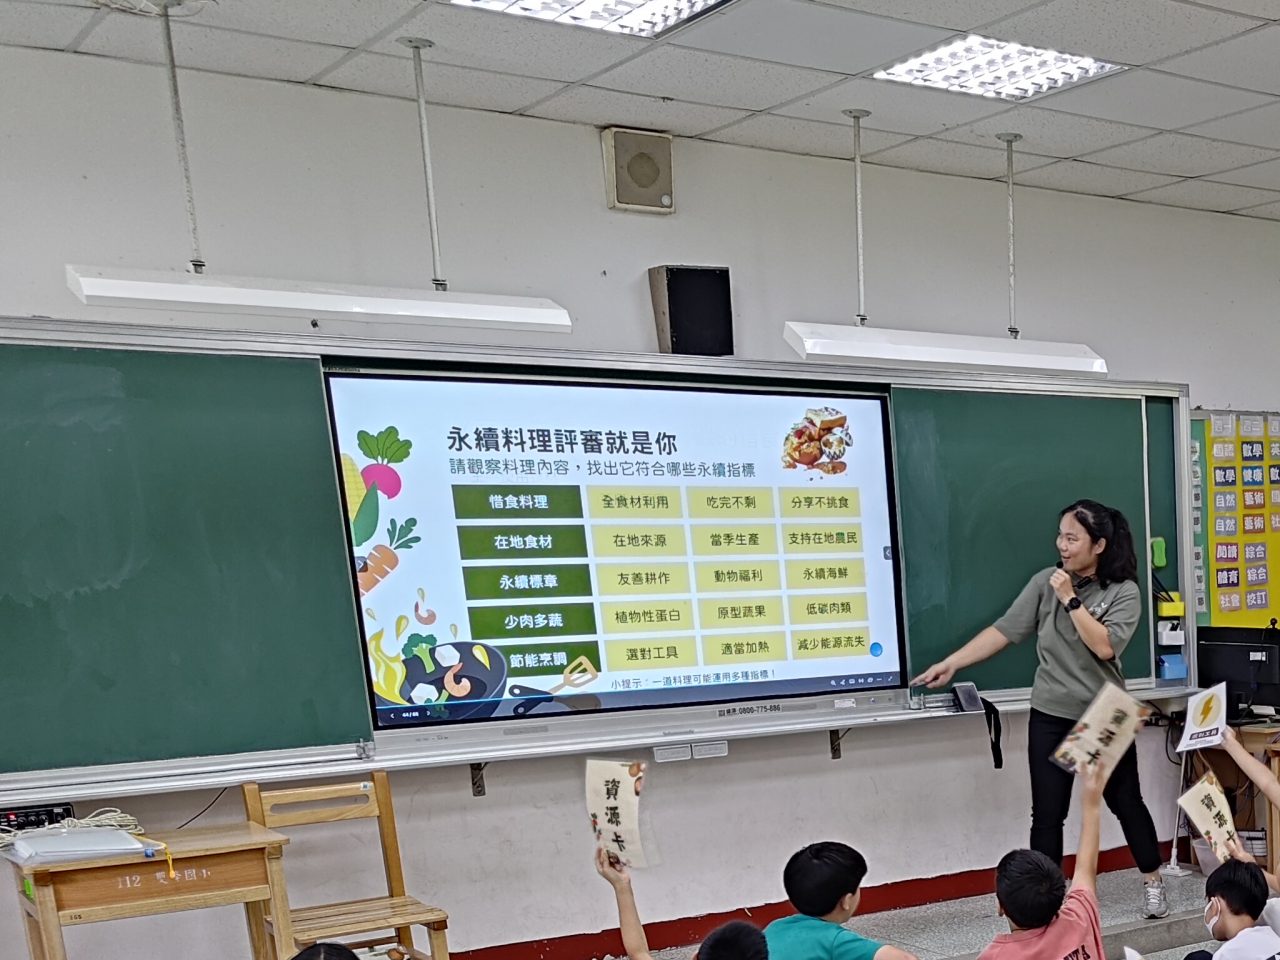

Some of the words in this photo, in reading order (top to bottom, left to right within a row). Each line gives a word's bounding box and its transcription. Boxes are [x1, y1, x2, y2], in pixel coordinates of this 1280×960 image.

[447, 426, 678, 455] 永續料理評審就是你
[1213, 445, 1235, 457] 國語
[1242, 443, 1262, 457] 數學
[1215, 469, 1236, 482] 數學
[489, 494, 549, 509] 惜食料理
[601, 495, 669, 509] 全食材利用
[706, 495, 757, 510] 吃完不剩
[791, 496, 850, 510] 分享不挑食
[1216, 494, 1235, 507] 自然
[1244, 491, 1264, 505] 藝術
[1216, 518, 1235, 531] 自然
[1244, 516, 1264, 530] 藝術
[494, 535, 552, 549] 在地食材
[612, 534, 667, 547] 在地來源
[709, 533, 760, 547] 當季生產
[788, 532, 858, 545] 支持在地農民
[1245, 545, 1265, 558] 綜合
[617, 571, 671, 585] 友善耕作
[714, 569, 763, 583] 動物福利
[803, 567, 849, 580] 永續海鮮
[1218, 570, 1238, 585] 體育
[1247, 568, 1267, 581] 綜合
[500, 575, 558, 589] 永續標章
[1220, 594, 1240, 607] 社會
[1246, 590, 1266, 604] 校訂
[717, 606, 767, 620] 原型蔬果
[806, 602, 852, 615] 低碳肉類
[504, 614, 563, 629] 少肉多蔬
[615, 609, 681, 624] 植物性蛋白
[721, 641, 770, 656] 適當加熱
[797, 636, 866, 652] 減少能源流失
[509, 652, 567, 667] 節能烹調
[626, 646, 679, 661] 選對工具
[604, 778, 626, 852] 資源卡
[1201, 793, 1237, 844] 資源卡
